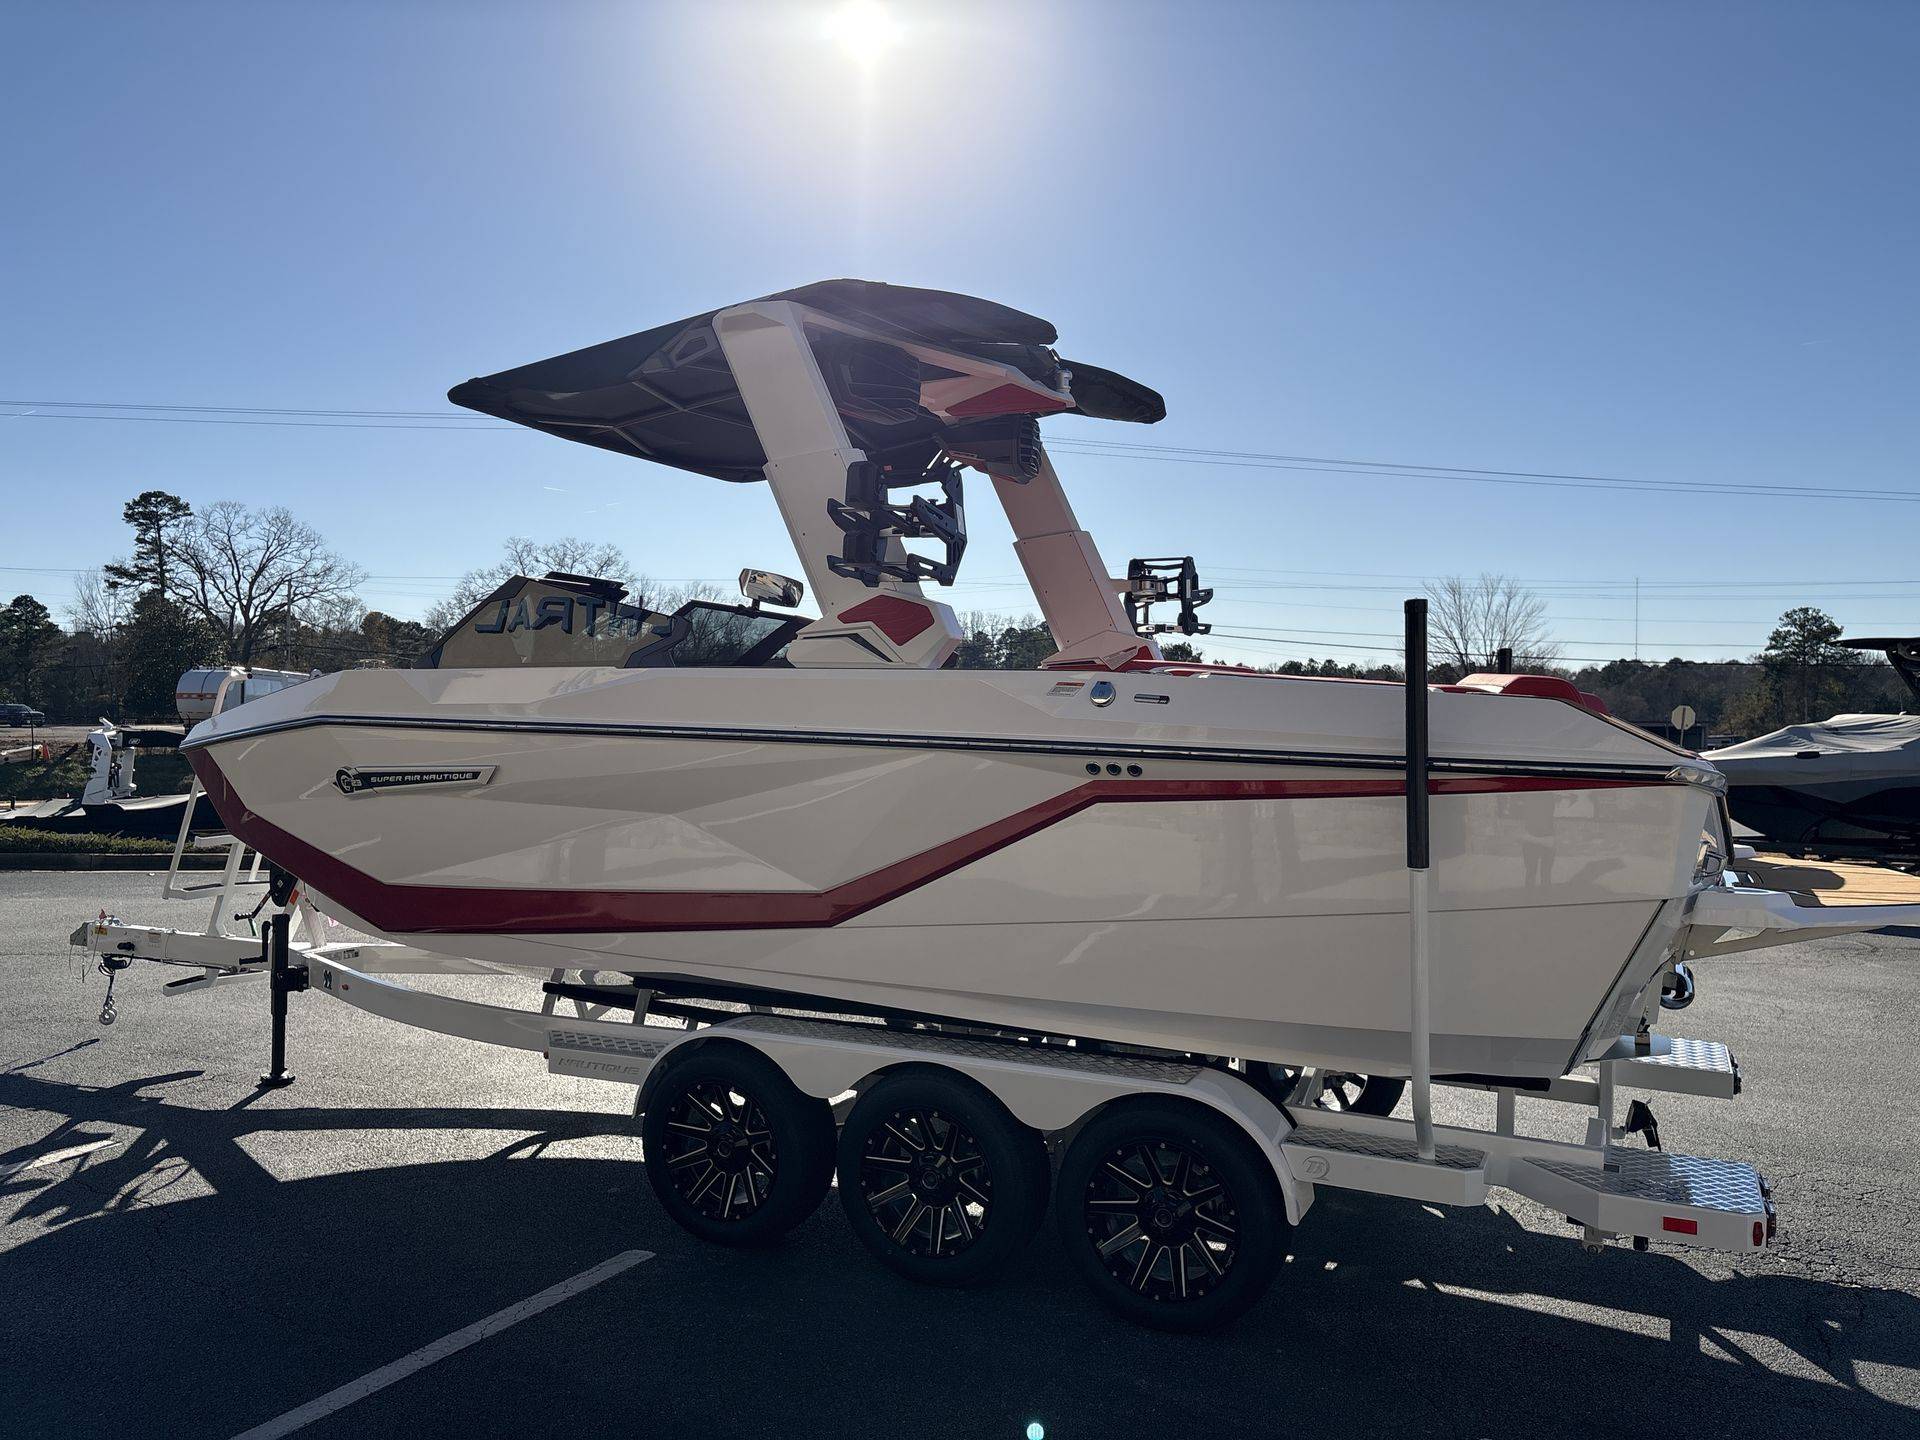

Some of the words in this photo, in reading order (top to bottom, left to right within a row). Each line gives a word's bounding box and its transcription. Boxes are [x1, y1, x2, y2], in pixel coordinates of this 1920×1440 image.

[370, 775, 402, 783] SUPER
[422, 772, 473, 780] NAUTIQUE
[558, 1057, 641, 1076] NAUTIQUE
